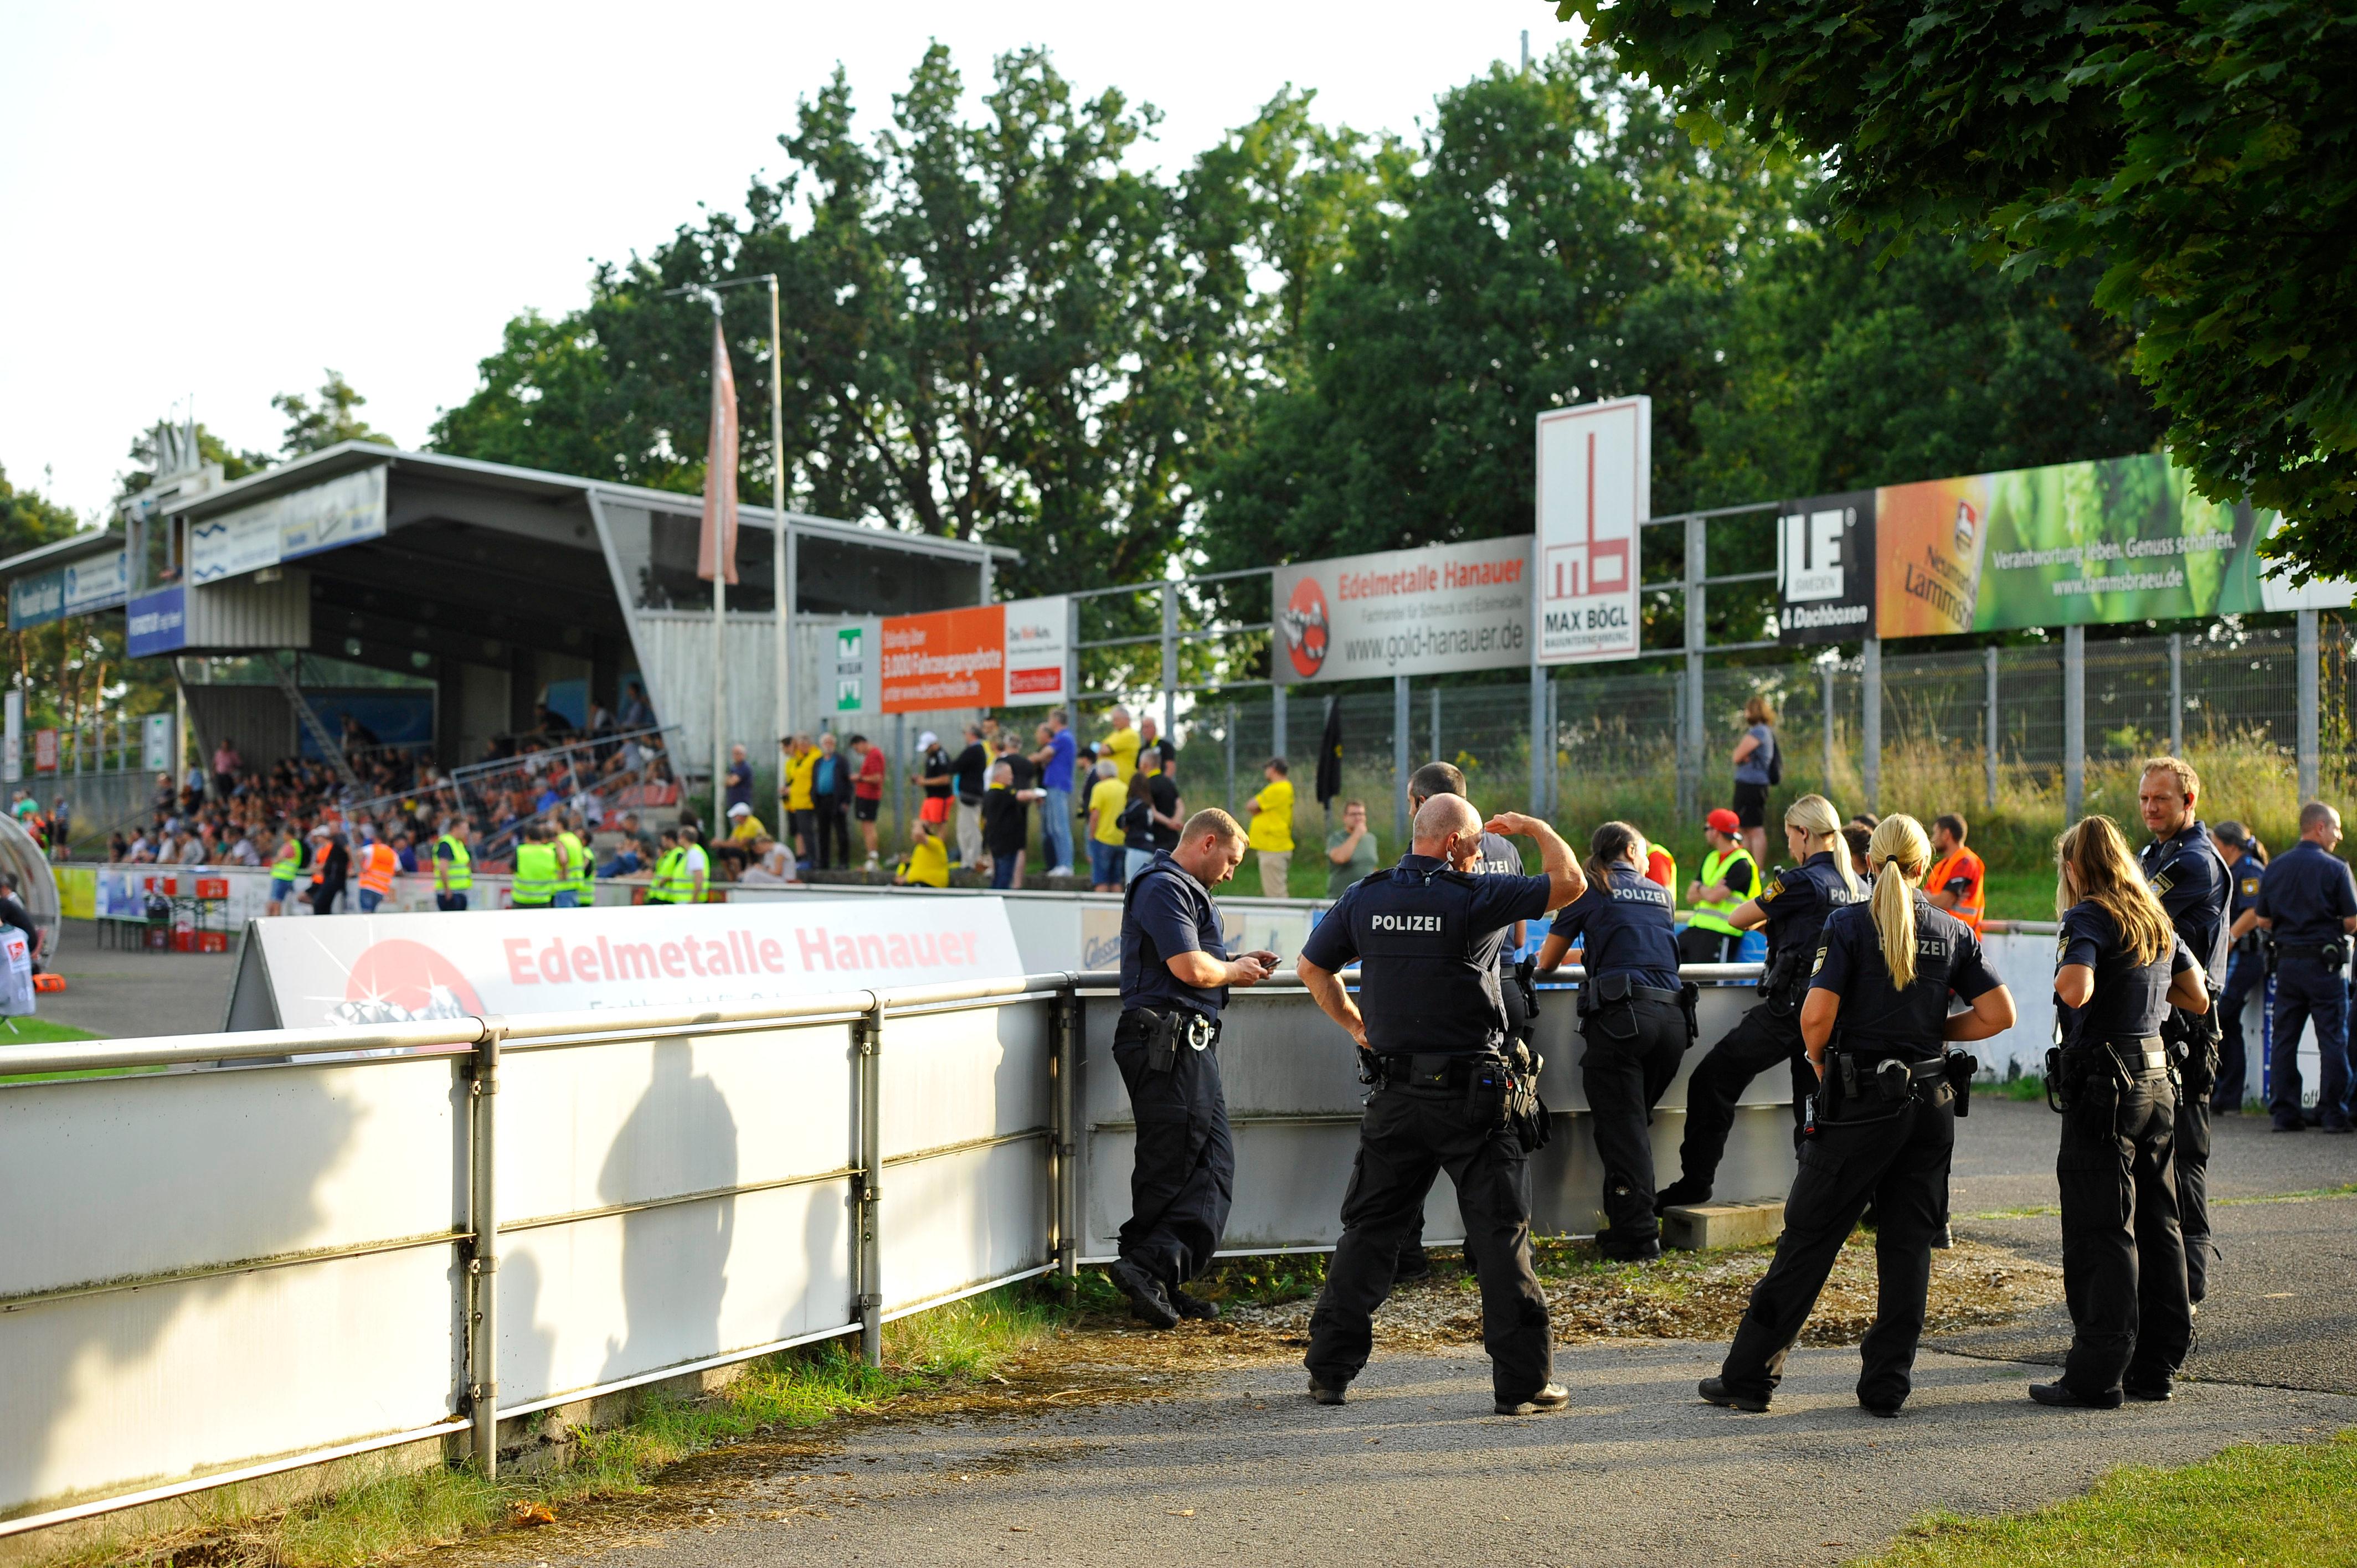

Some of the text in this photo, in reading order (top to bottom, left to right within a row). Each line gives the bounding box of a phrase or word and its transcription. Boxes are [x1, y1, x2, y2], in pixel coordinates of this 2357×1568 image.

[1994, 528, 2236, 570] Verantwortung leben. Genuss schaffen.
[1338, 557, 1524, 601] Edelmetalle Hanauer
[2052, 565, 2184, 596] www.lammsbraeu.de
[1545, 602, 1629, 633] MAX BÖGL
[1793, 604, 1869, 628] Dachboxen
[1346, 618, 1524, 666] www.gold-hanauer.de
[1471, 860, 1509, 874] OLIZEI
[1612, 888, 1666, 904] POLIZEI
[1372, 915, 1441, 932] POLIZEI
[503, 926, 979, 985] Edelmetalle Hanauer
